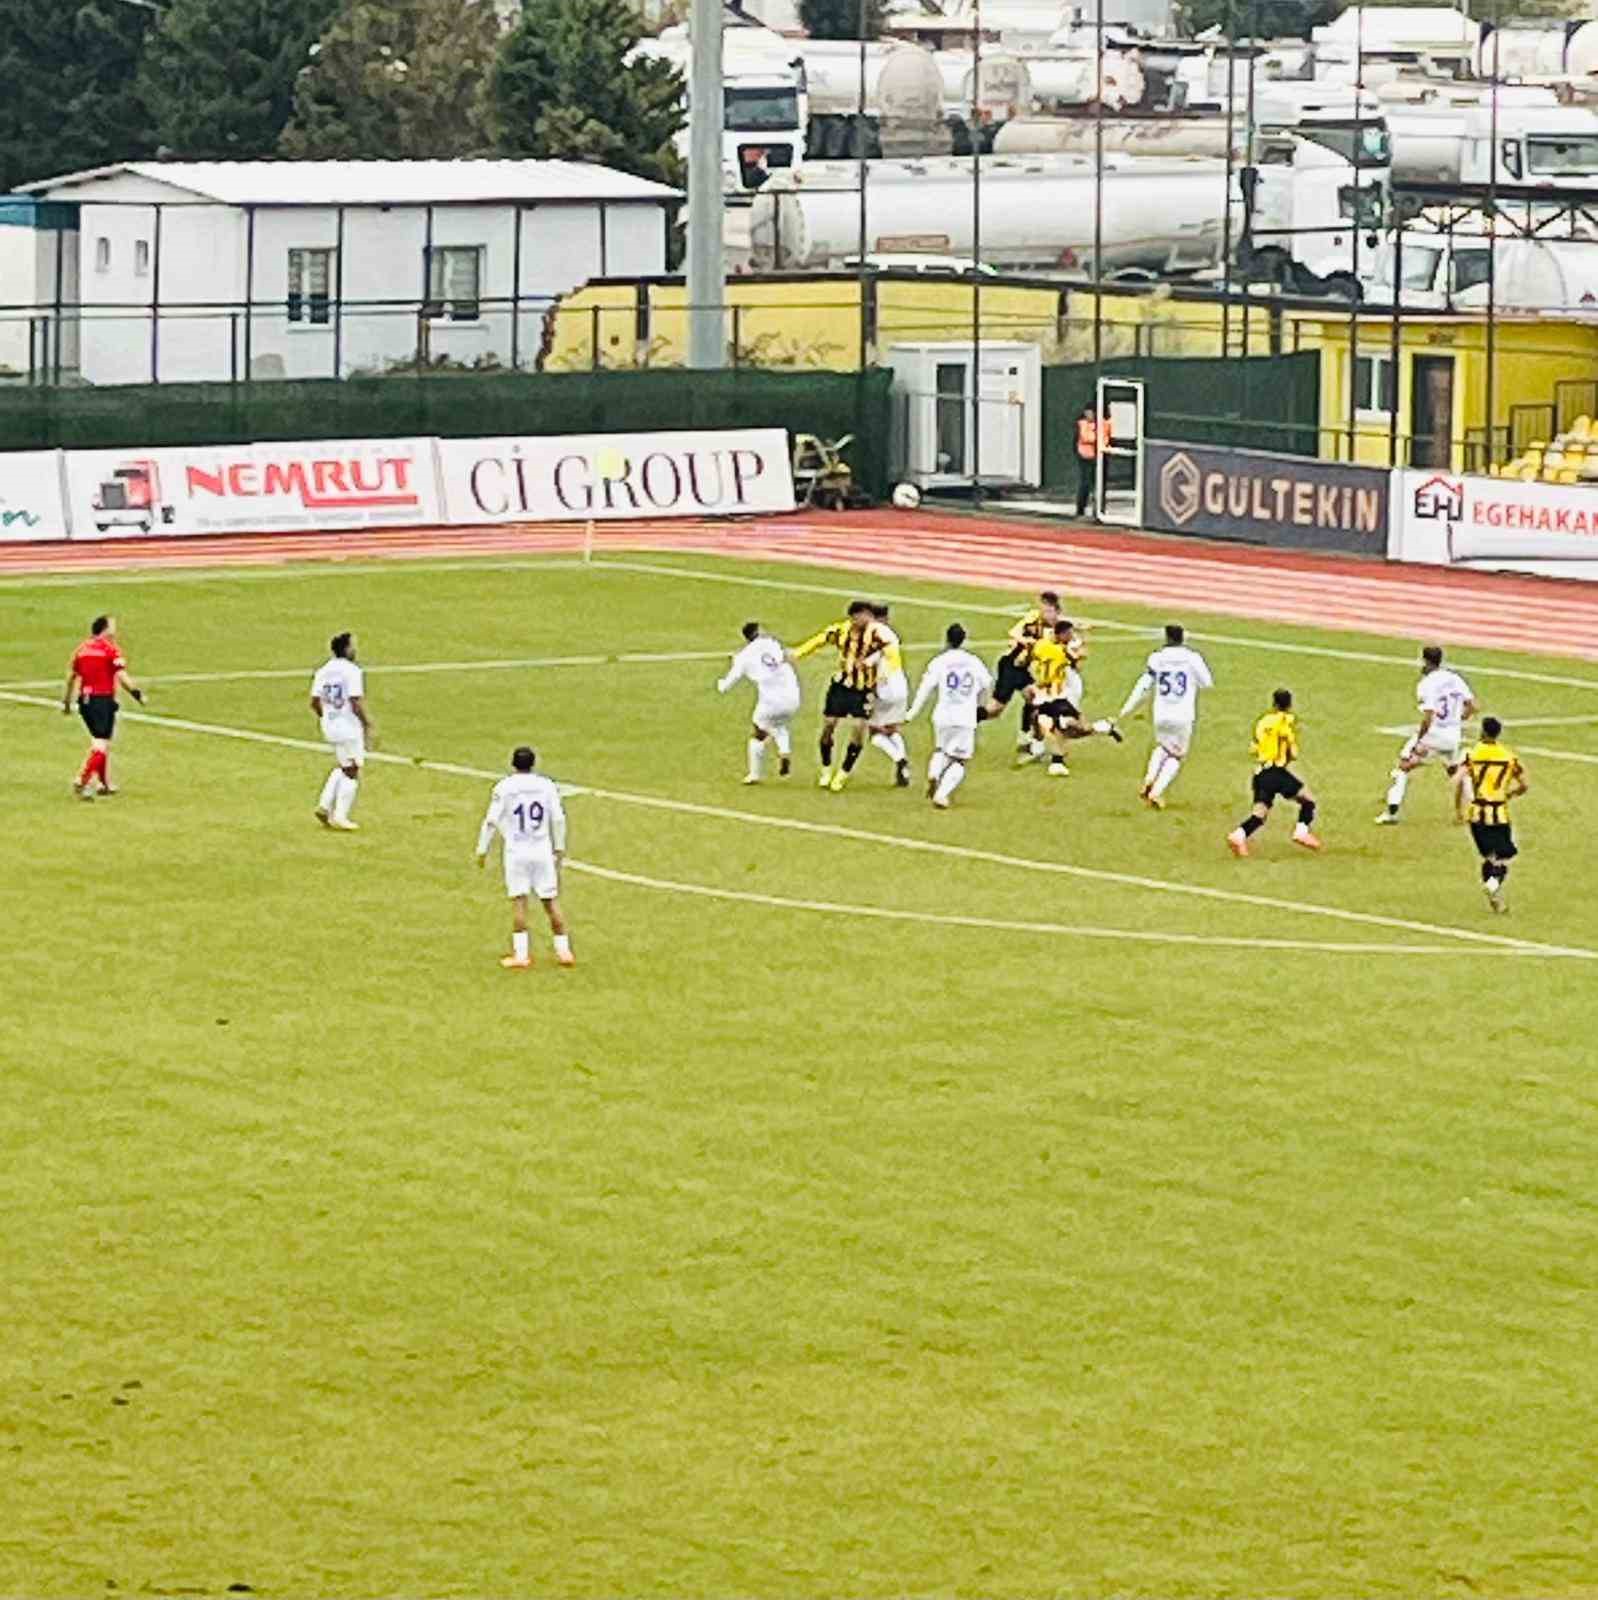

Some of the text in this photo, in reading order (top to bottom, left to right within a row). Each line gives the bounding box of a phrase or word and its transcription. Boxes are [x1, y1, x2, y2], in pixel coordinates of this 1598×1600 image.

[185, 458, 417, 507] NEMRUT
[553, 449, 765, 511] GROUP
[1159, 671, 1187, 697] 53
[513, 800, 545, 833] 19
